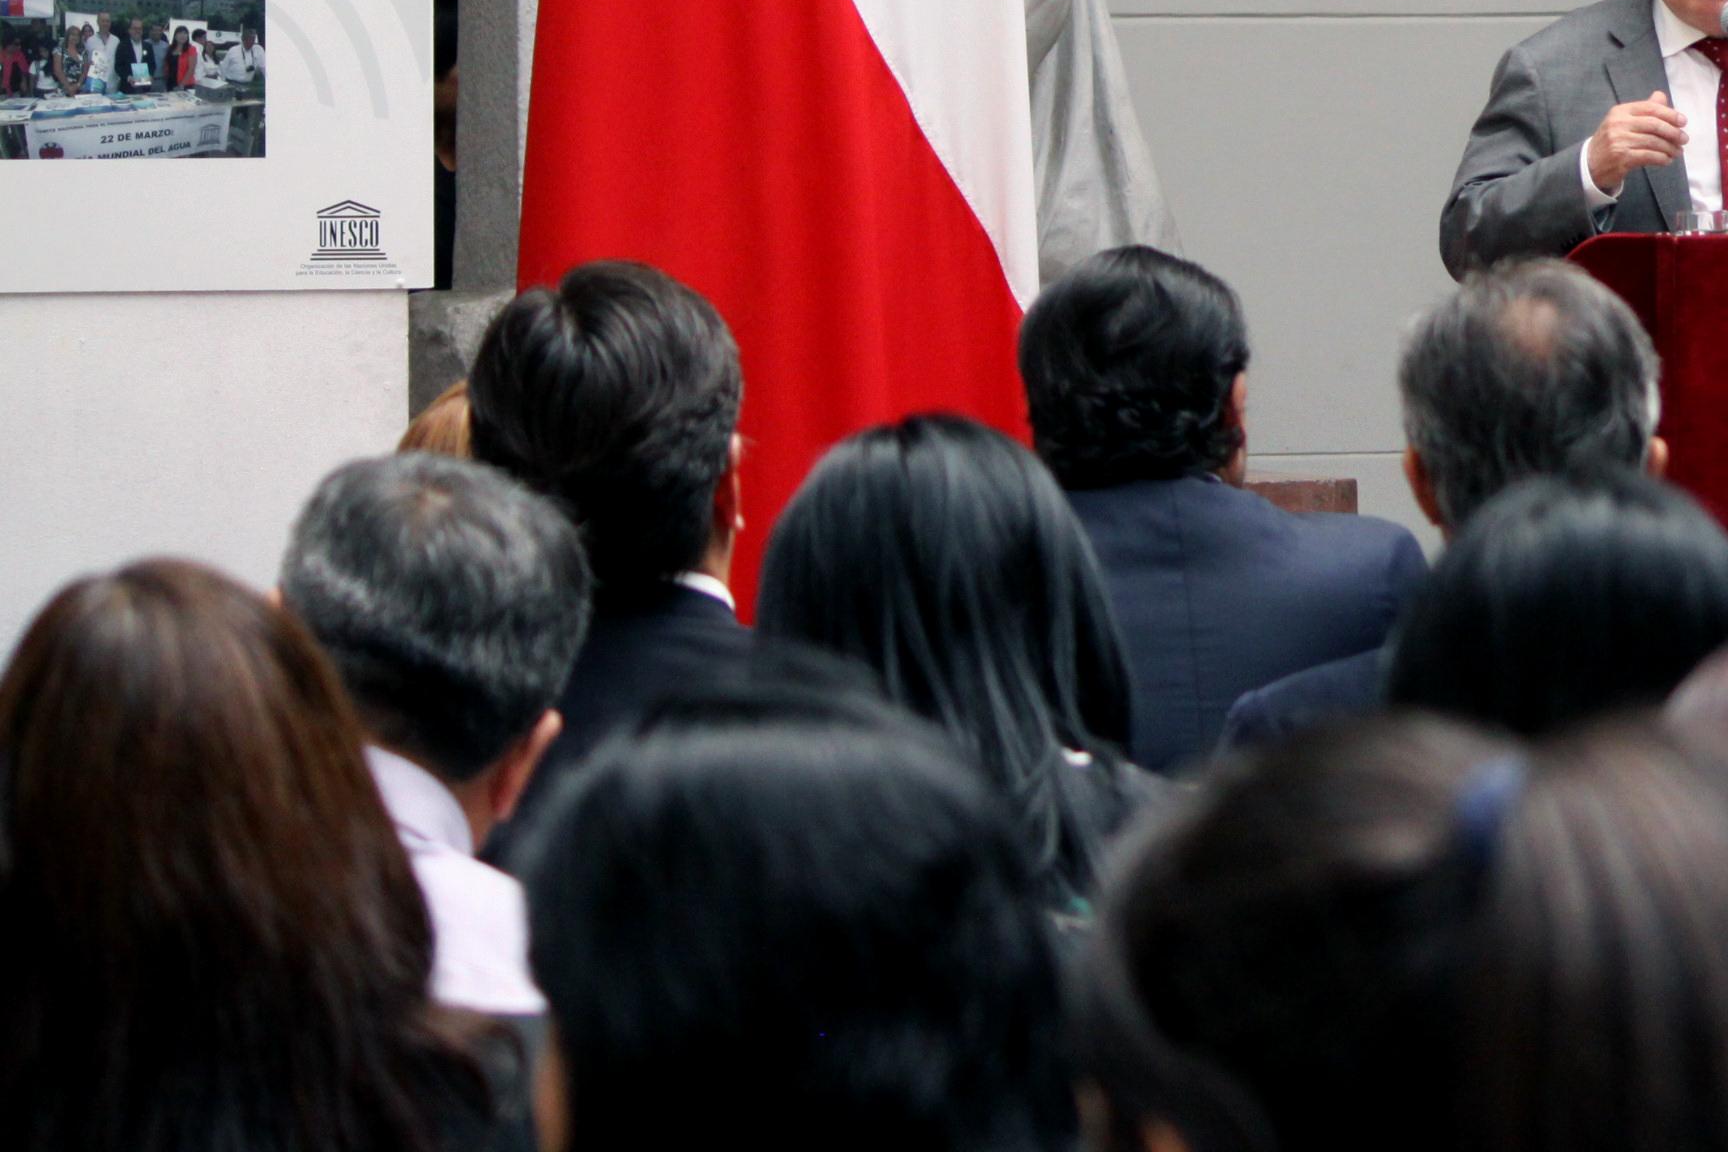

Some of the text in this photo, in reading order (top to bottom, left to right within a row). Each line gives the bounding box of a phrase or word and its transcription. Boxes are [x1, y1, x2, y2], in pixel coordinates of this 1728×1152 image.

[100, 135, 114, 143] 22
[118, 133, 131, 142] DE
[320, 220, 379, 247] UNESCO
